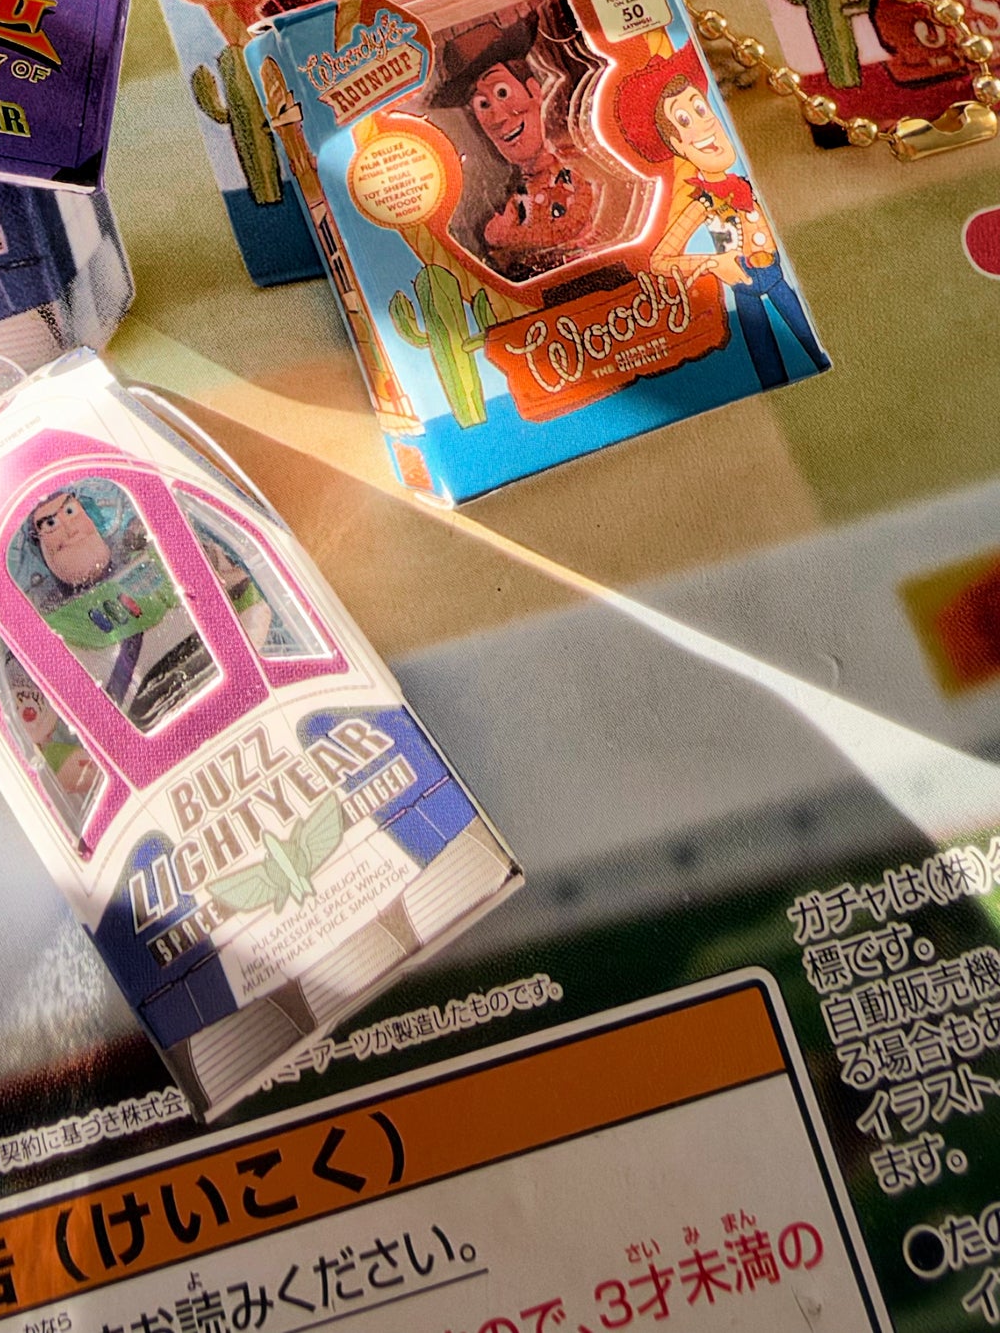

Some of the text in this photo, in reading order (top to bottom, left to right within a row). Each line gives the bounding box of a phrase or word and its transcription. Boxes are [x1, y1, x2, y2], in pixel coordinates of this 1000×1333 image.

[622, 3, 644, 22] 50
[11, 59, 52, 84] OF
[298, 13, 414, 91] Woody's
[330, 51, 413, 114] ROUNDUP
[360, 147, 418, 172] FILM REPLICA
[371, 141, 404, 159] DELUXE
[374, 182, 430, 207] INTERACTIVE
[504, 259, 719, 394] Woody
[592, 337, 670, 379] THE SHERIFF
[166, 722, 291, 837] BUZZ
[129, 718, 395, 934] LIGHTYEAR
[155, 758, 413, 963] SPACE RANGER
[792, 842, 1000, 939] ガチャは(株)
[240, 858, 394, 980] HIGH PRESSURE SPACE WINGS!
[241, 864, 411, 997] MULTI-PHRASE VOICE SIMULATOR!
[252, 860, 370, 956] PULSATING LASERLIGHT!
[807, 926, 931, 990] 標です。
[825, 950, 1000, 1039] 自動販売機
[874, 1137, 963, 1190] ます。
[625, 1237, 661, 1264] さい
[682, 1225, 701, 1246] み
[720, 1209, 758, 1234] まん
